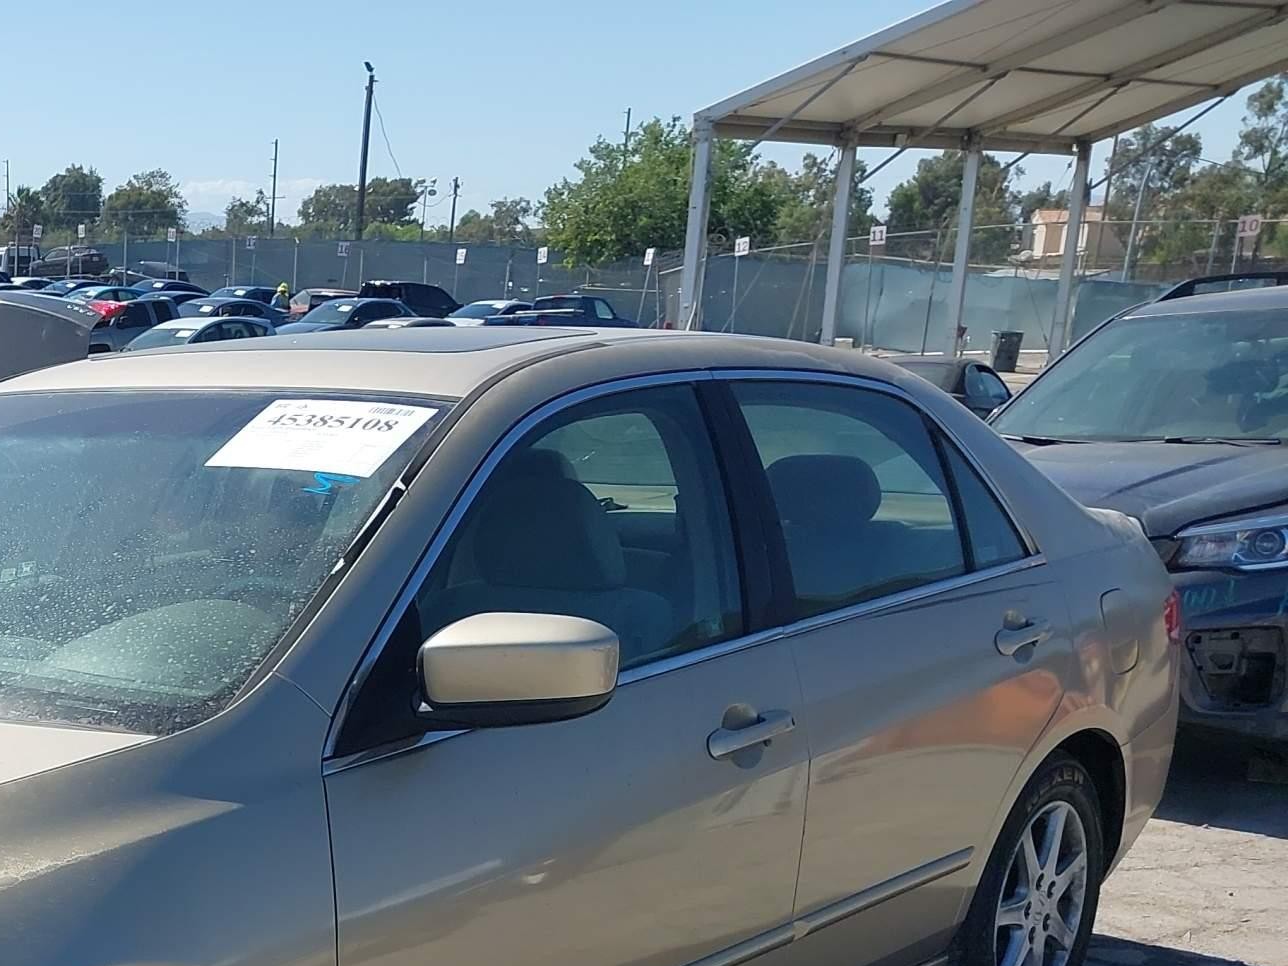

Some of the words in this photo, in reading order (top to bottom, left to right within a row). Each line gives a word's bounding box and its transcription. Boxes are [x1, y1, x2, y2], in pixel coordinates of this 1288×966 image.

[1240, 219, 1259, 233] 10
[871, 230, 884, 242] 11
[735, 240, 749, 253] 12
[267, 413, 399, 432] 45385108
